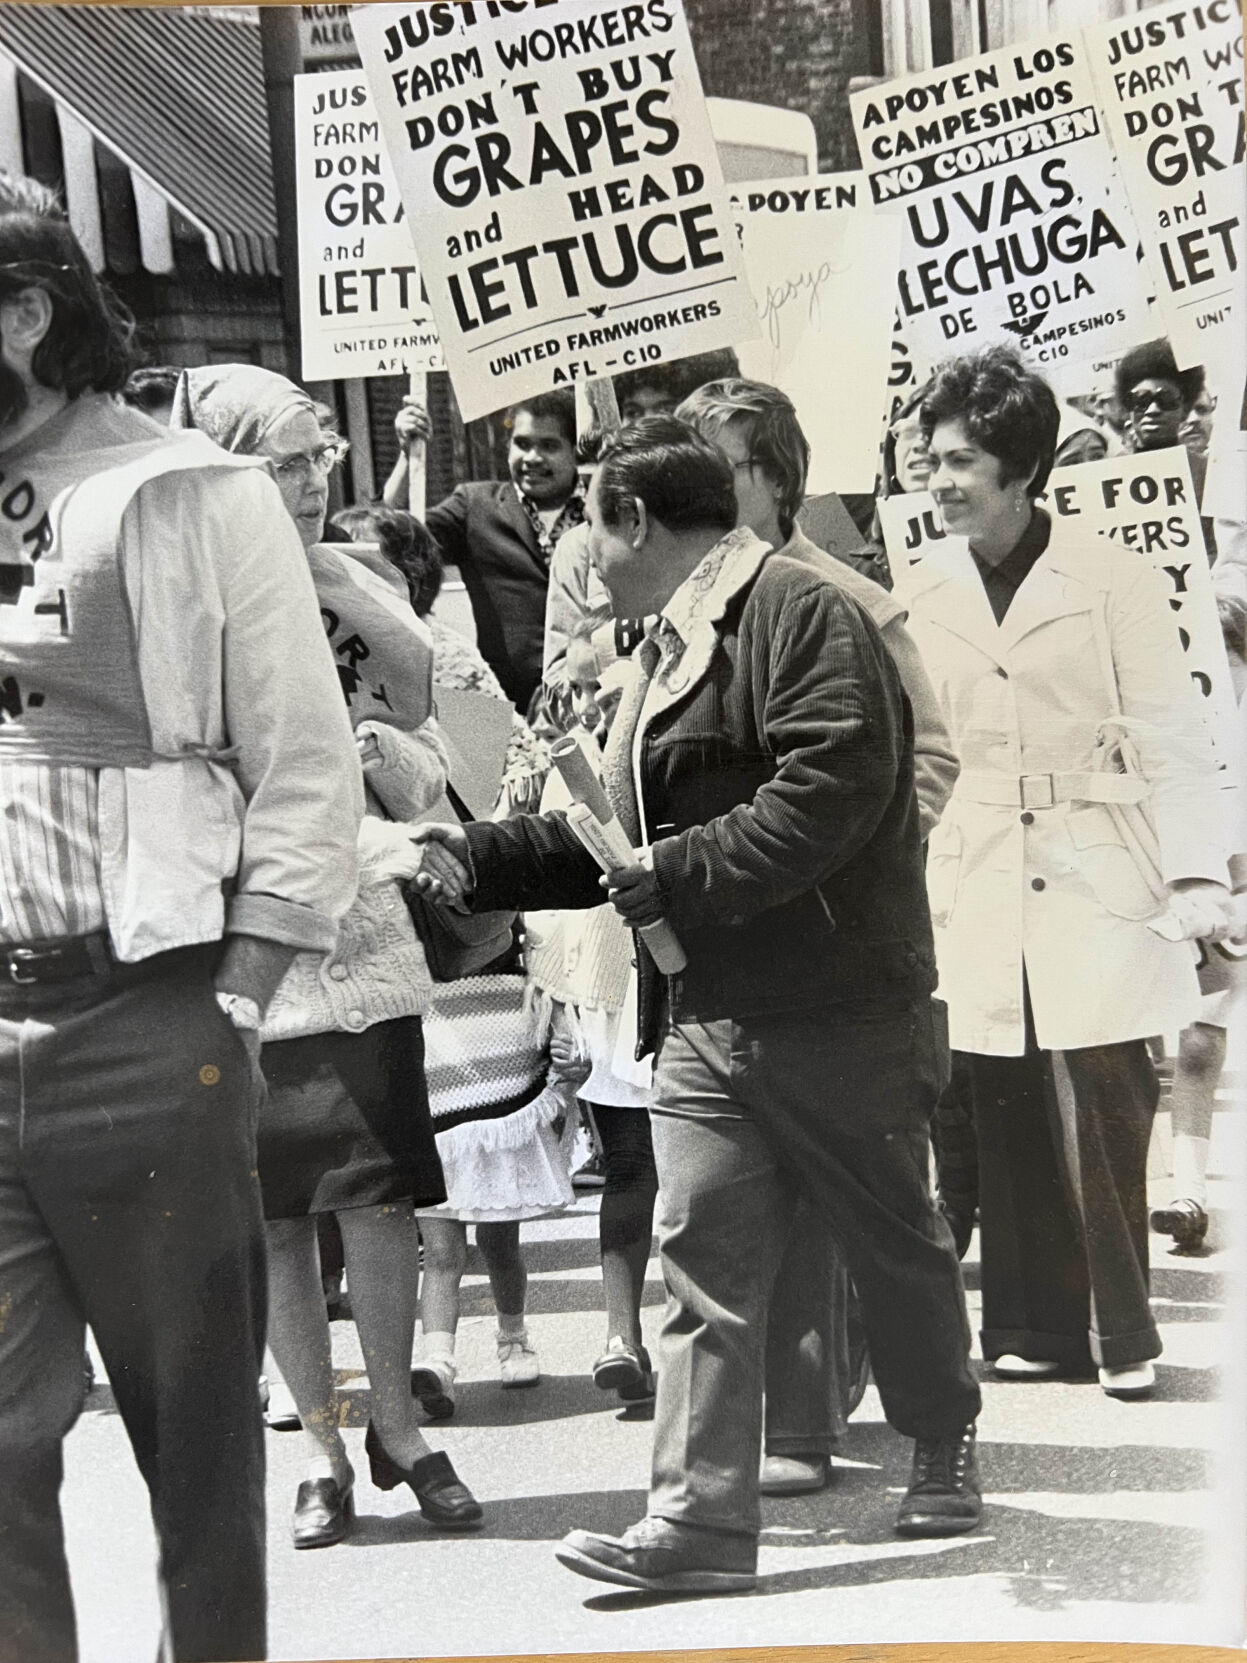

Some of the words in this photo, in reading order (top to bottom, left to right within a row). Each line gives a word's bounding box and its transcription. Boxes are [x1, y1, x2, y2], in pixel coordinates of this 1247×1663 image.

[384, 2, 558, 63] JUSTI
[392, 46, 484, 107] FARM
[495, 1, 677, 71] WORKERS
[1108, 0, 1243, 66] JUSTIC
[312, 85, 368, 115] JUS
[576, 49, 676, 102] BUY
[863, 64, 999, 130] APOYEN
[1013, 43, 1075, 81] LOS
[1114, 56, 1191, 102] FARM
[314, 121, 379, 147] FARM
[871, 81, 1074, 161] CAMPESINOS
[315, 154, 381, 179] DON
[433, 89, 679, 208] GRAPES
[874, 163, 924, 200] NO
[933, 108, 1097, 180] COMPREN
[567, 163, 705, 222] HEAD
[729, 185, 856, 213] POYEN
[1157, 190, 1207, 229] and
[324, 236, 365, 262] and
[446, 211, 502, 258] and
[1159, 216, 1240, 292] LET
[447, 203, 725, 333] LETTUCE
[898, 208, 1127, 317] LECHUGA
[319, 266, 430, 316] LETT
[940, 307, 978, 340] DE
[1007, 272, 1096, 318] BOLA
[334, 338, 388, 354] UNITED
[489, 338, 561, 376] UNITED
[566, 300, 722, 352] FARMWORKERS
[1020, 309, 1127, 351] CAMPESINOS
[1101, 475, 1187, 510] FOR
[1098, 515, 1191, 555] ERS
